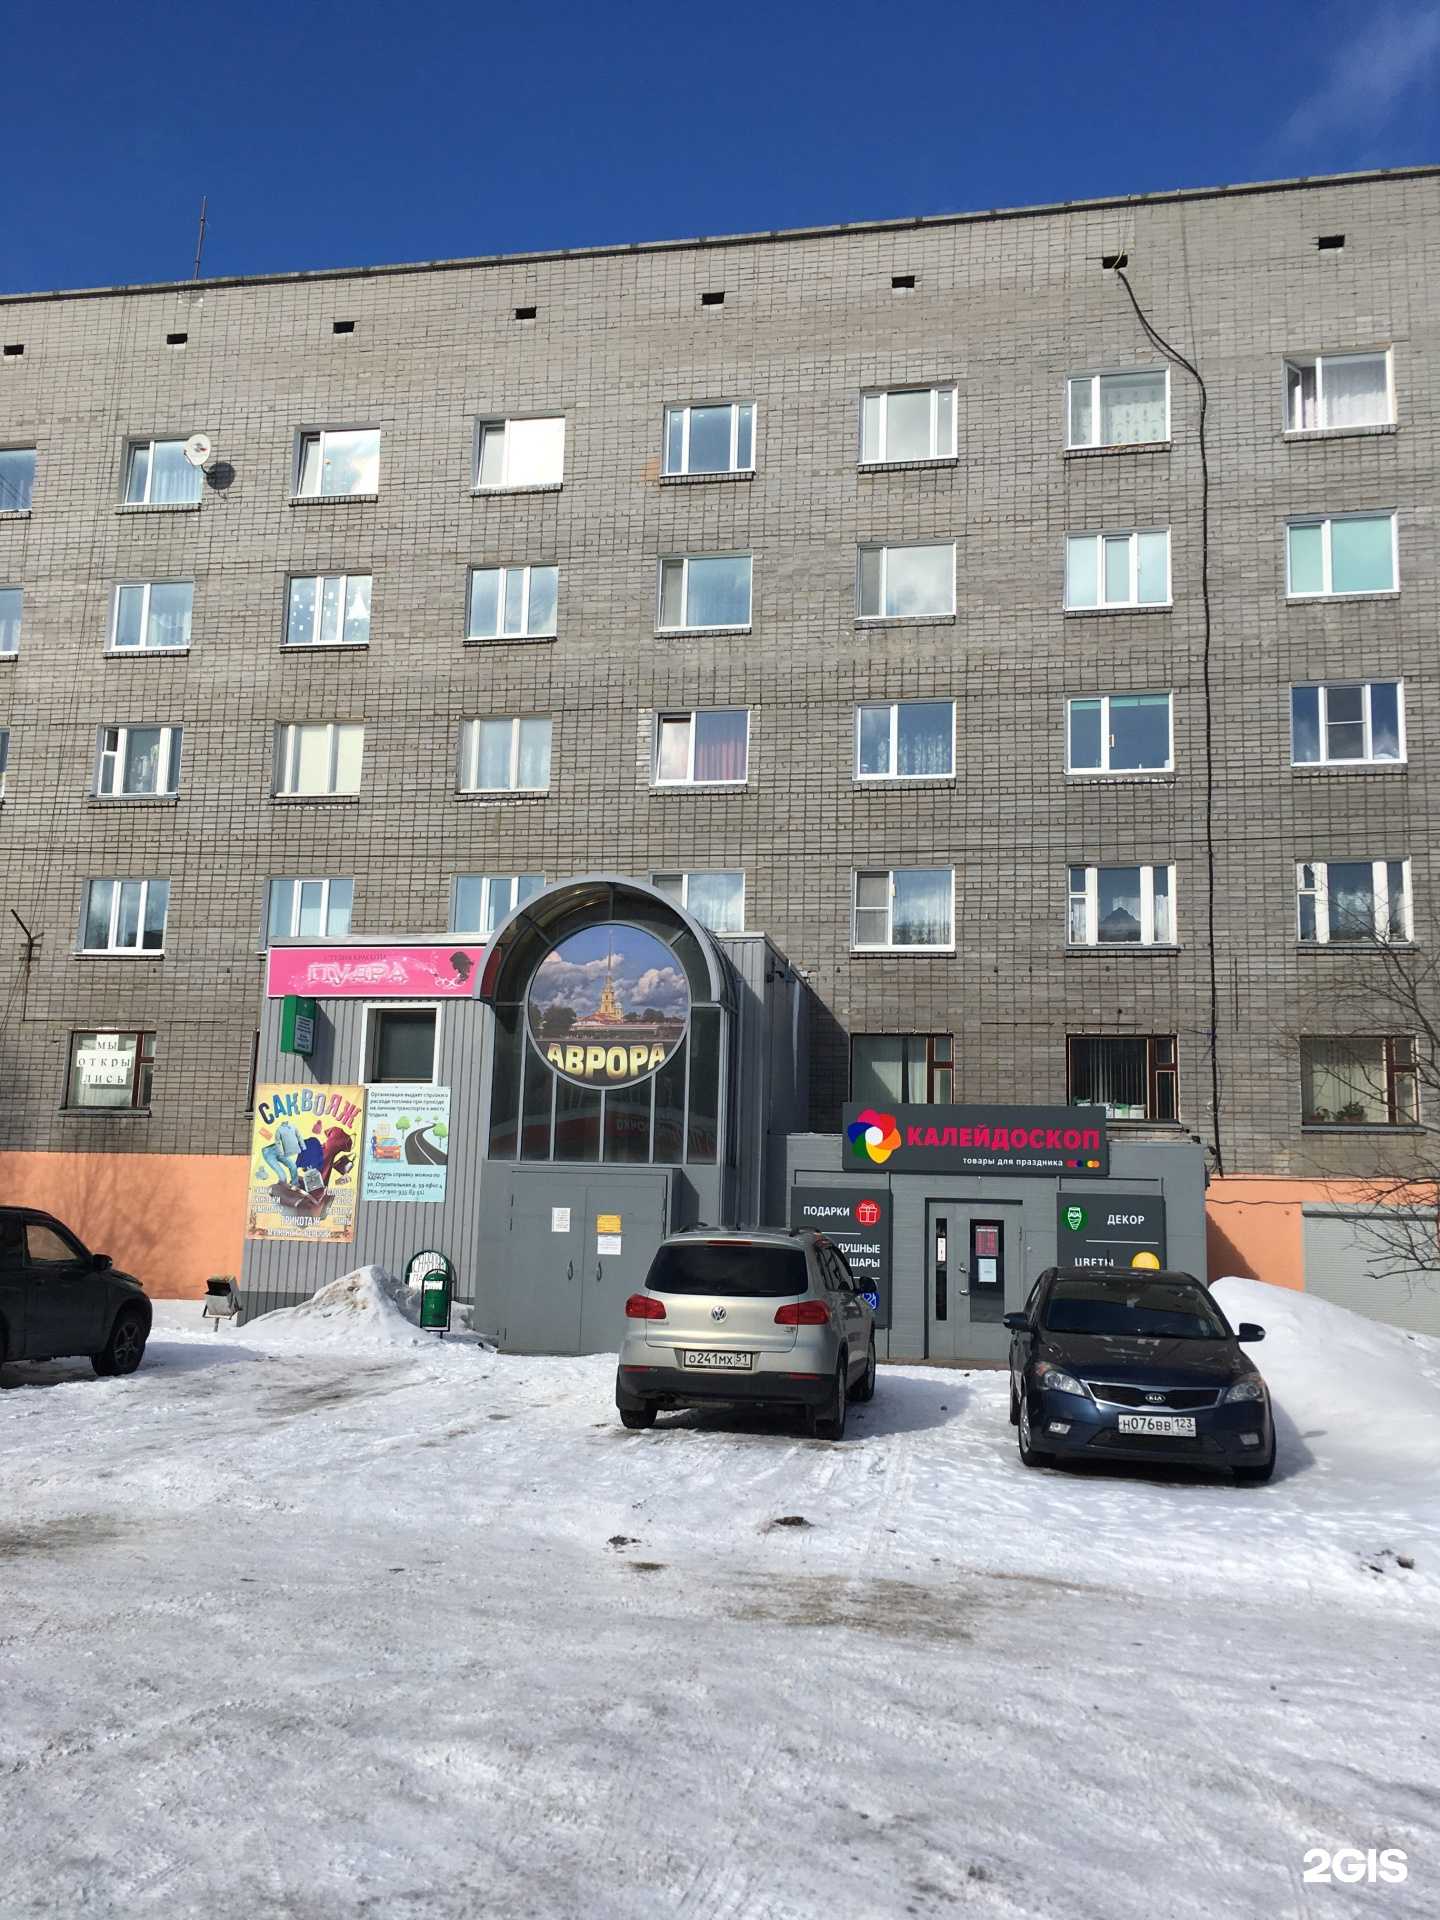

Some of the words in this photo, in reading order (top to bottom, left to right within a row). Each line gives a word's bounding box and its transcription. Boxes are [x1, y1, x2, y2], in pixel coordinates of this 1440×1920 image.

[97, 1041, 118, 1050] МЫ
[547, 1042, 666, 1080] АВРОРА
[258, 1088, 362, 1129] САКВОЯЖ
[907, 1123, 1100, 1149] КАЛЕЙДОСКОП
[963, 1157, 994, 1166] товары
[997, 1158, 1014, 1166] для
[1016, 1158, 1063, 1167] праздника
[803, 1205, 850, 1217] ПОДАРКИ
[1107, 1214, 1145, 1225] ДЕКОР
[838, 1243, 881, 1254] ДУШНЫЕ
[849, 1258, 881, 1268] ШАРЫ
